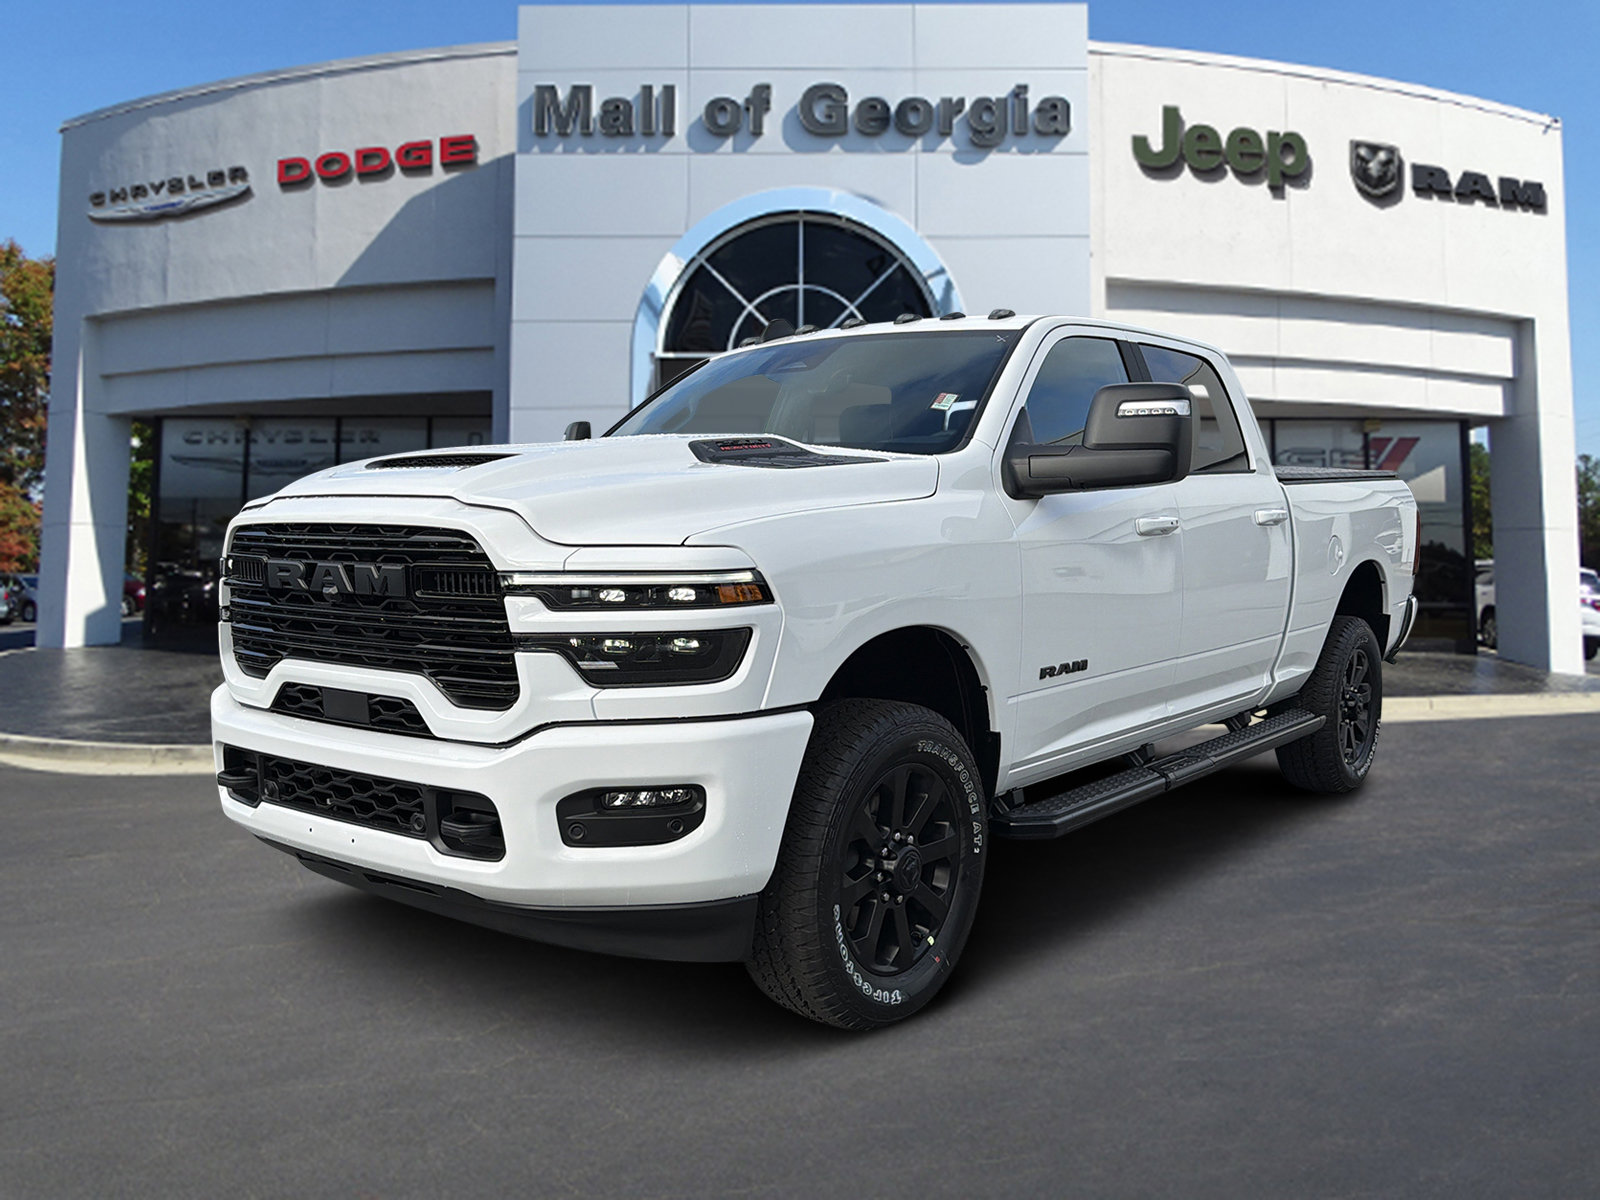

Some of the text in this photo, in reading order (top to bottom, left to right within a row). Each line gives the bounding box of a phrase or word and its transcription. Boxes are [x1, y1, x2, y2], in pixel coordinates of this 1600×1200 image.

[531, 83, 1073, 148] Mall of Georgia
[277, 134, 477, 188] DODGE
[1131, 105, 1311, 190] Jeep
[89, 166, 250, 207] CHRYSLER
[1411, 163, 1547, 214] RAM
[182, 430, 381, 444] CHRYSLER
[267, 559, 406, 597] RAM
[1039, 658, 1088, 680] RAM
[917, 739, 980, 815] TRANSFORCE
